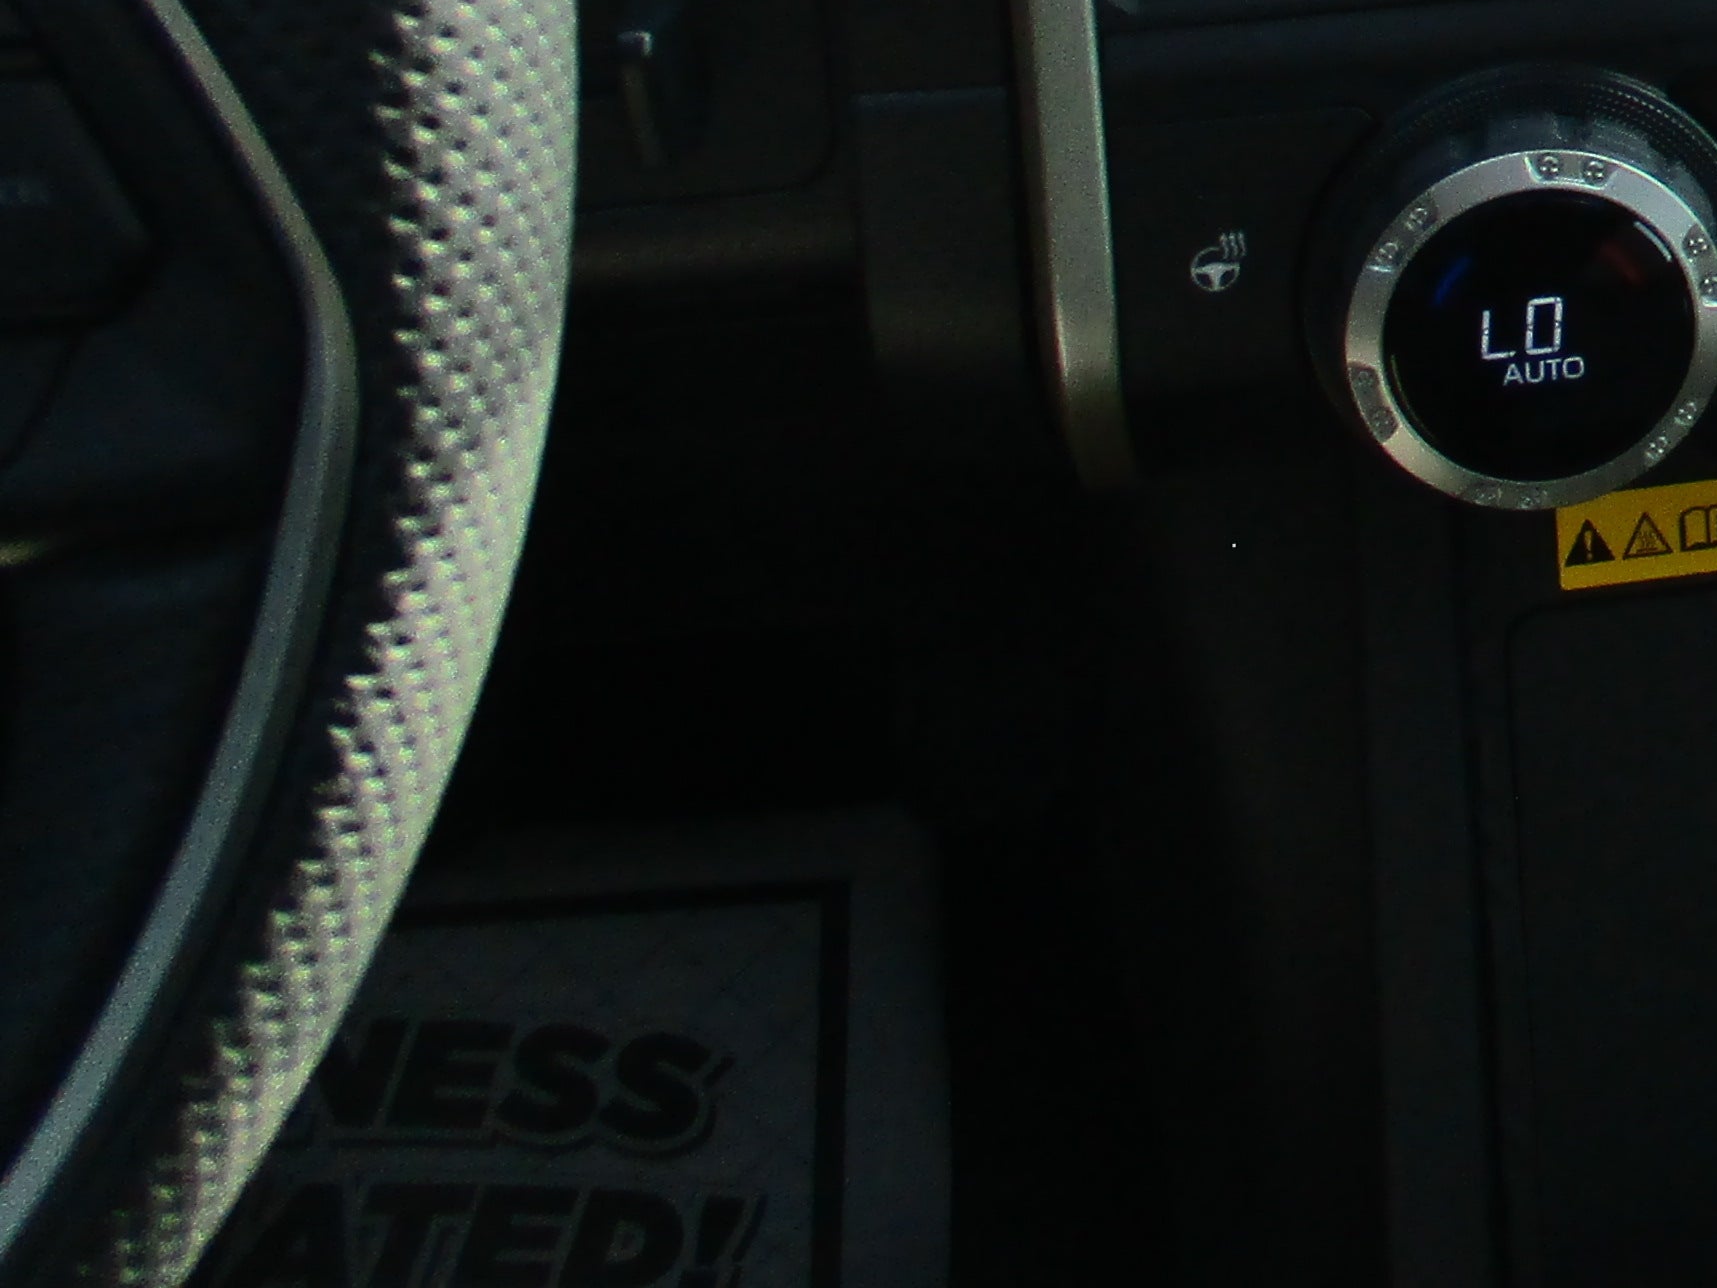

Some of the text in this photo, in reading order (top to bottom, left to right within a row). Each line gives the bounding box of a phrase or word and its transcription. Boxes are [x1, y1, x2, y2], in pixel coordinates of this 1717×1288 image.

[1502, 354, 1586, 386] AUTO
[316, 1016, 724, 1142] NESS
[212, 1180, 766, 1288] ATED!
